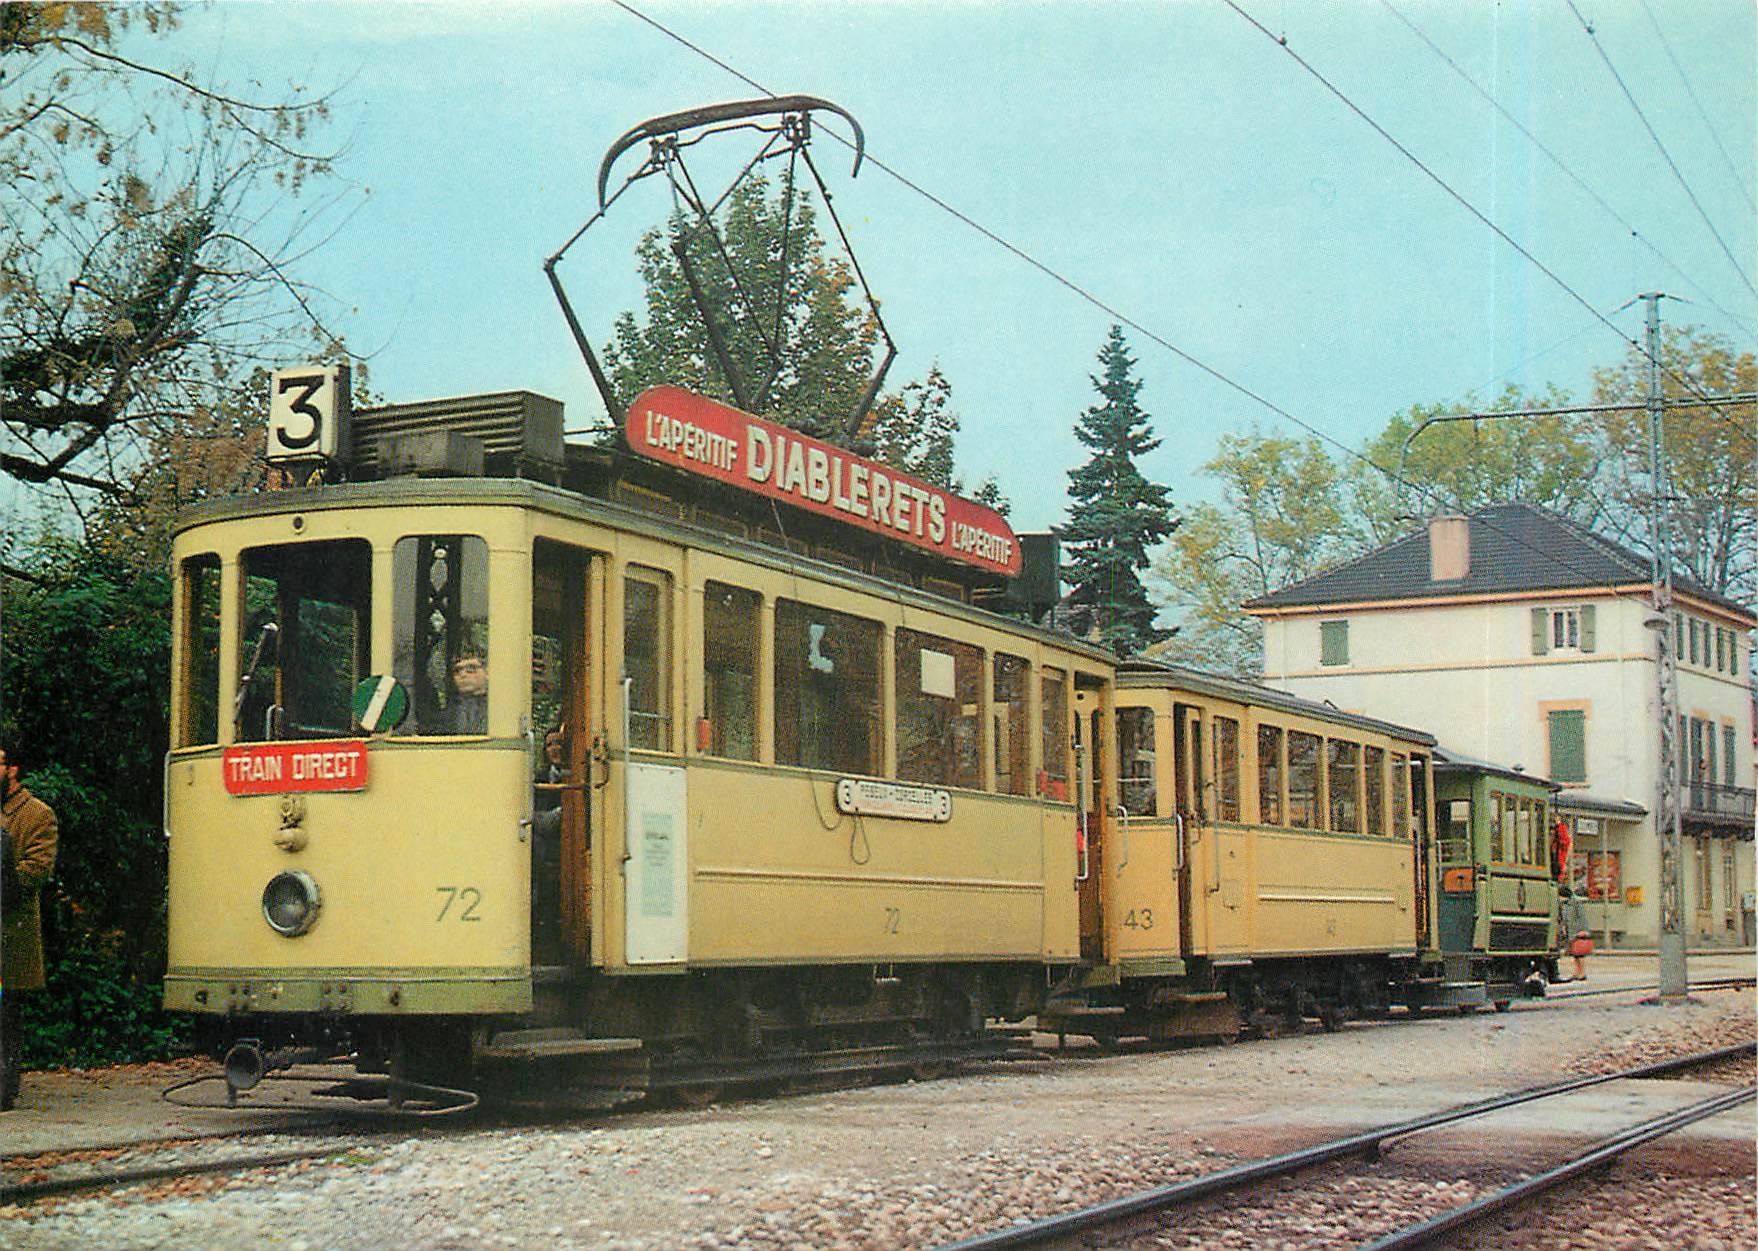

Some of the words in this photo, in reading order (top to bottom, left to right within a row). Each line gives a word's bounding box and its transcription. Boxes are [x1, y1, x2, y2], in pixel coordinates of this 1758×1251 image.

[277, 375, 324, 449] 3
[646, 410, 738, 472] L'APÉRITIF
[747, 425, 945, 544] DIABLERETS
[228, 756, 282, 782] TRAIN
[292, 752, 360, 780] DIRECT
[435, 887, 481, 922] 72
[1123, 908, 1153, 930] 43
